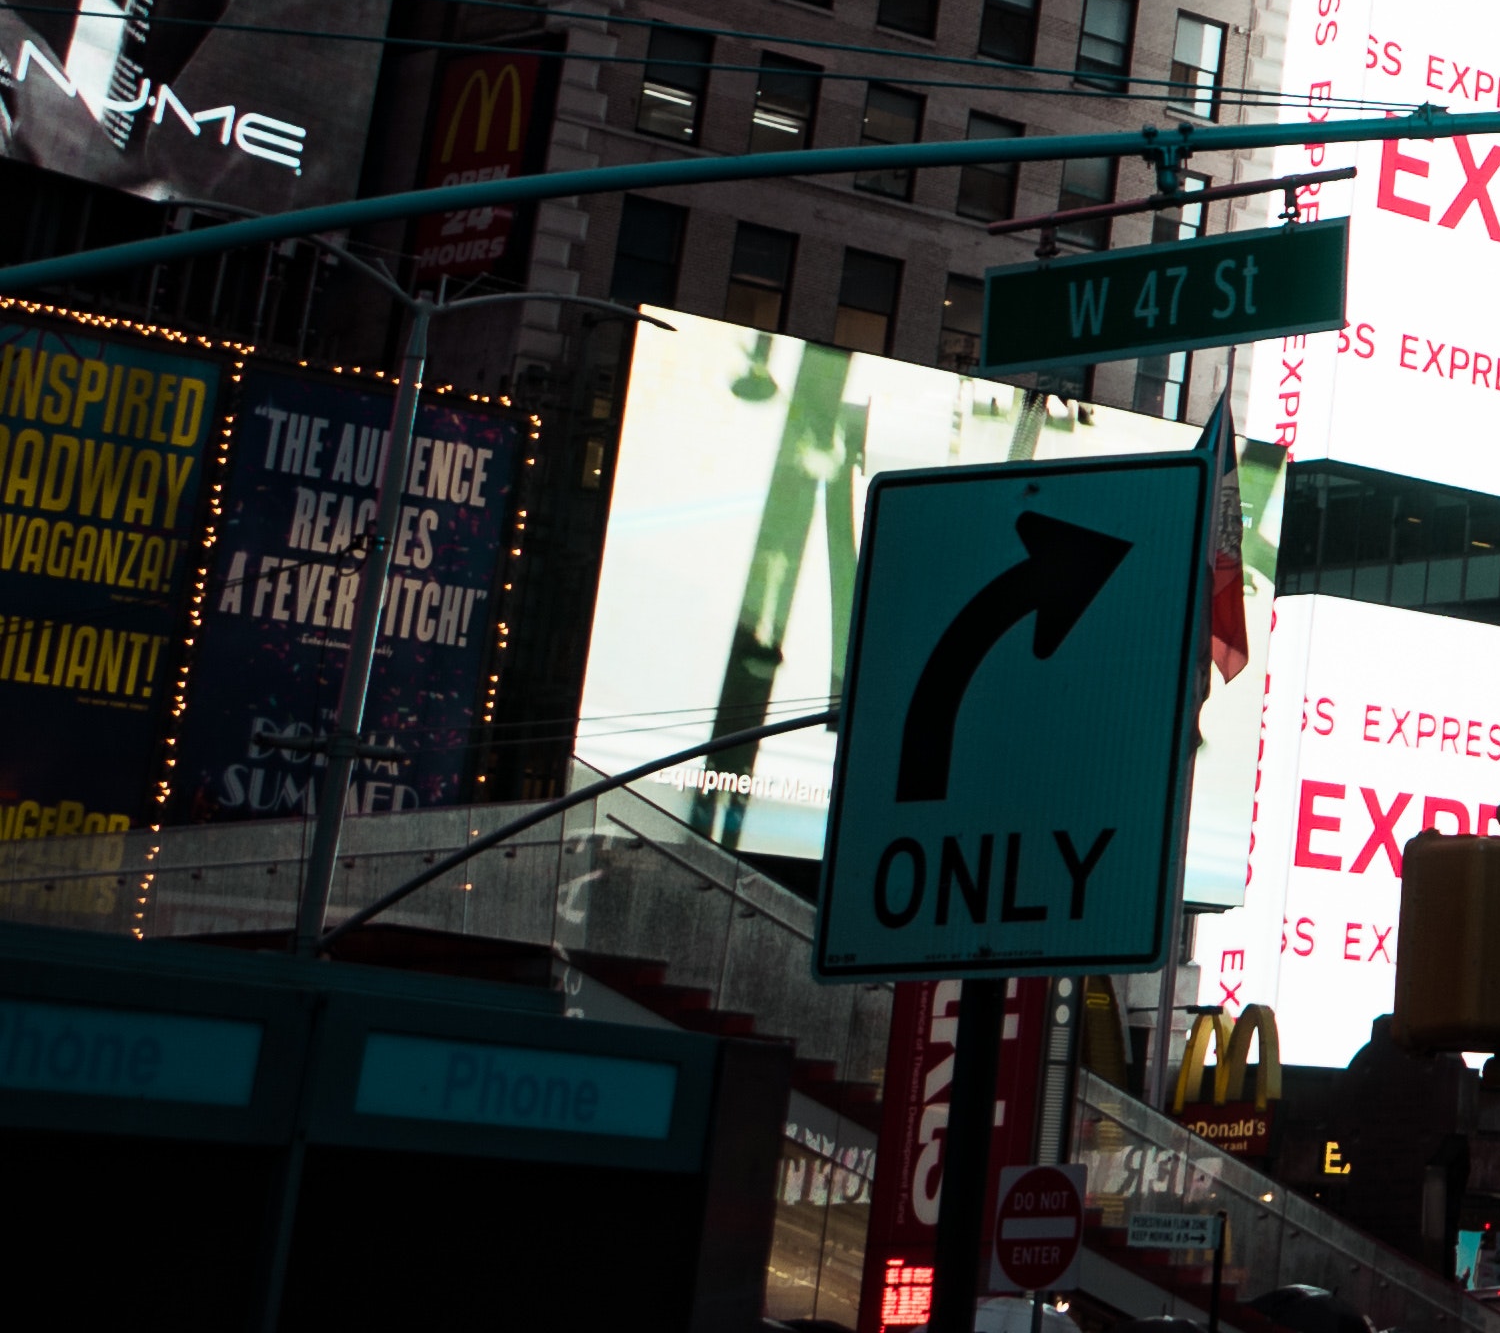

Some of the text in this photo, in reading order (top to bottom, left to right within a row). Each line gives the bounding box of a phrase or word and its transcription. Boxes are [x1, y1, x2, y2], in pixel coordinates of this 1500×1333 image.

[420, 235, 507, 269] HOURS
[1069, 252, 1260, 338] W 47 St
[332, 422, 492, 507] AUENCE
[288, 486, 438, 569] REACES
[219, 549, 357, 631] A FEVER
[874, 829, 1117, 929] ONLY
[445, 1052, 600, 1122] Phone
[1013, 1187, 1068, 1211] DO NOT
[1012, 1245, 1061, 1266] ENTER
